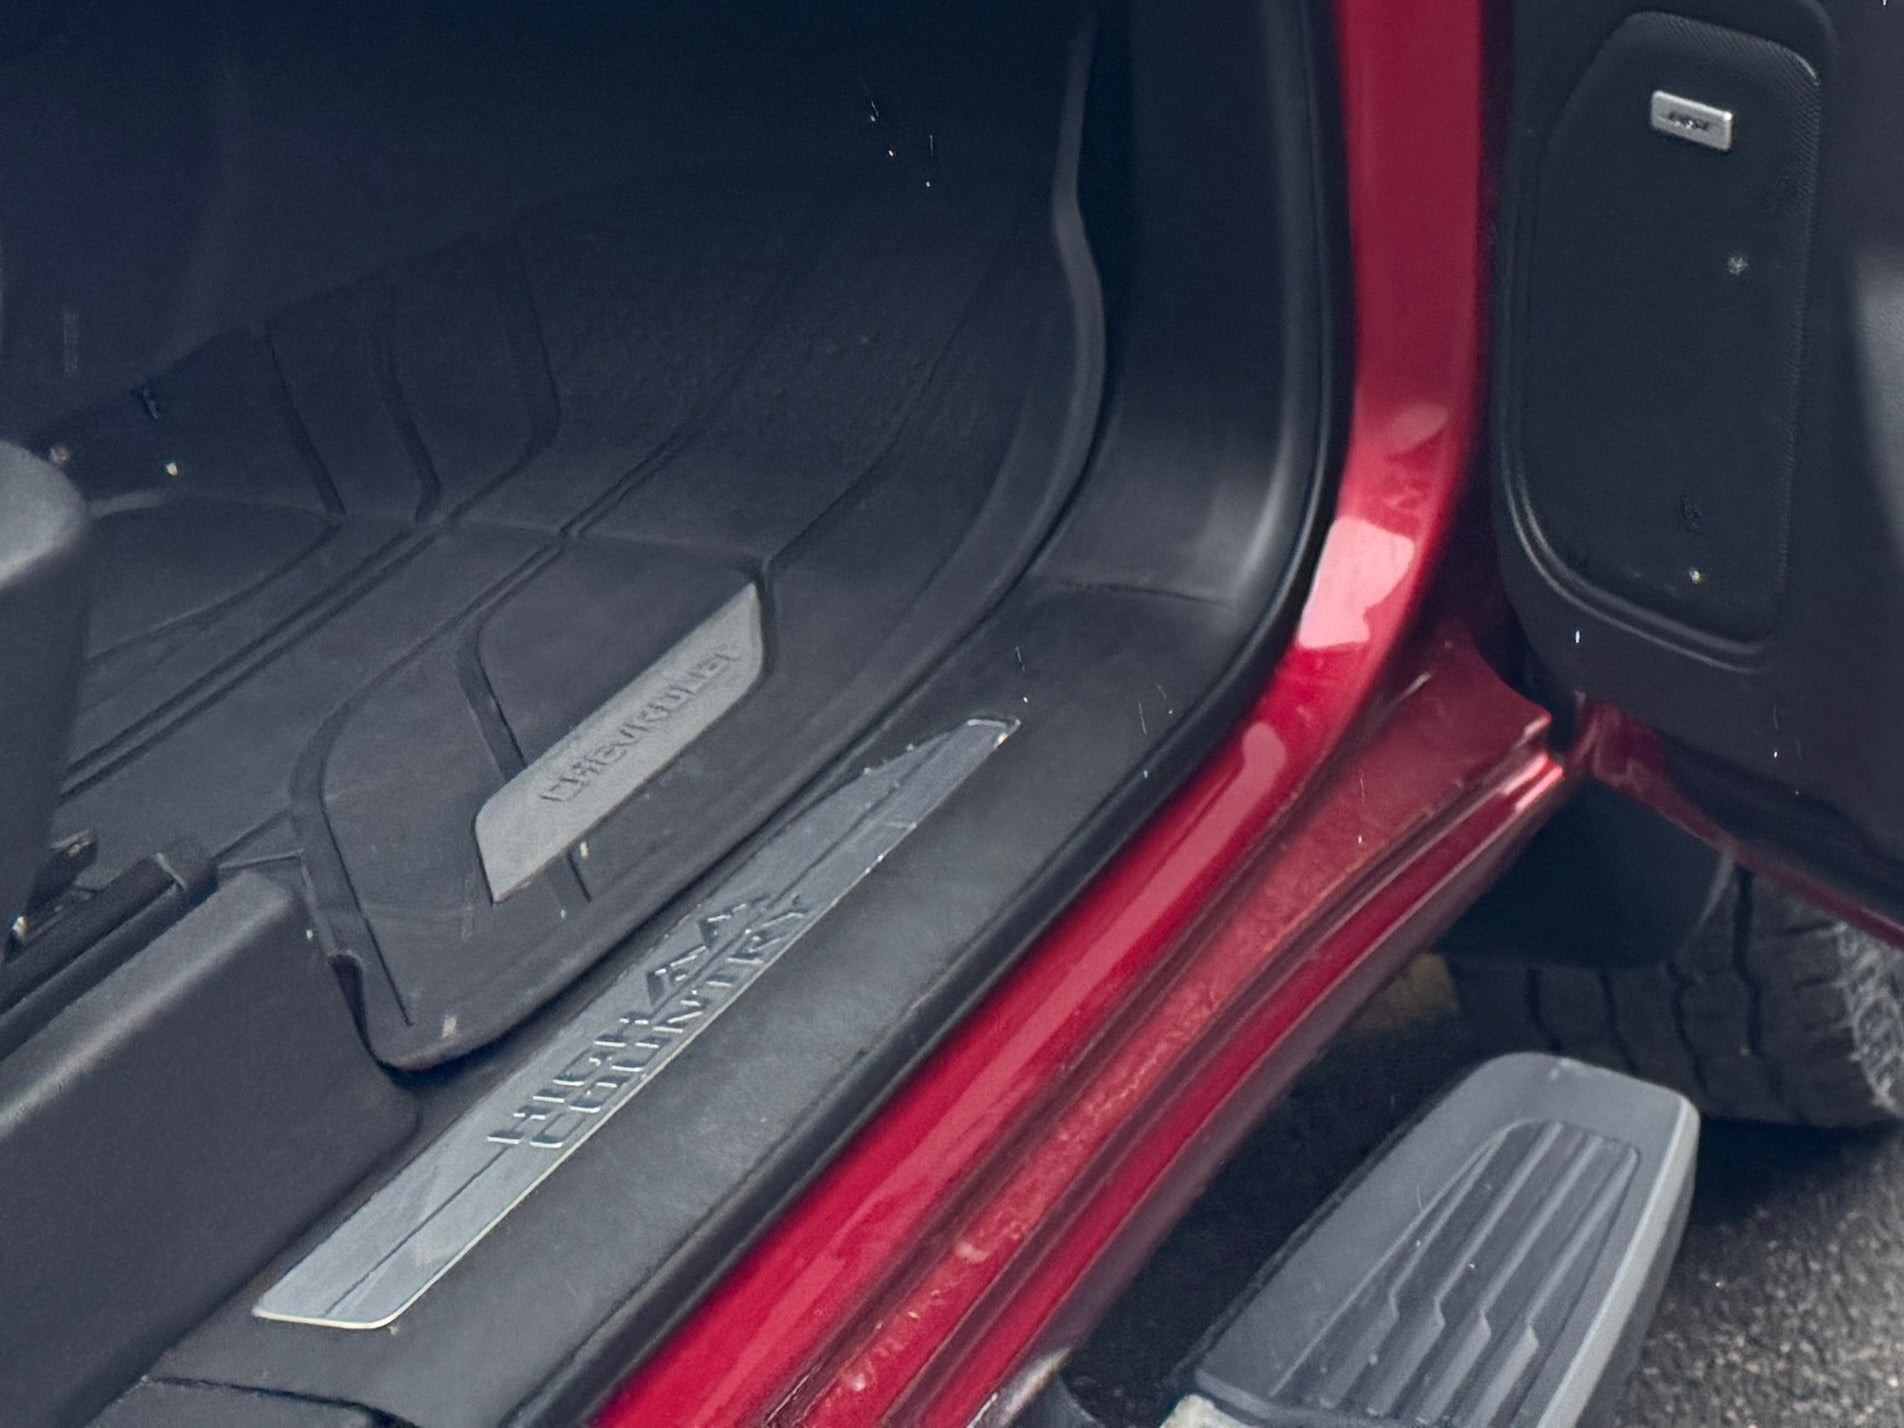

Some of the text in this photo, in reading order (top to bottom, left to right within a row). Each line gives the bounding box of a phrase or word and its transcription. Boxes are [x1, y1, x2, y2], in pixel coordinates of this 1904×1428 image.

[538, 645, 740, 802] CHEVROLET
[486, 1010, 650, 1145] HIGH
[528, 906, 806, 1148] COUNTRY
